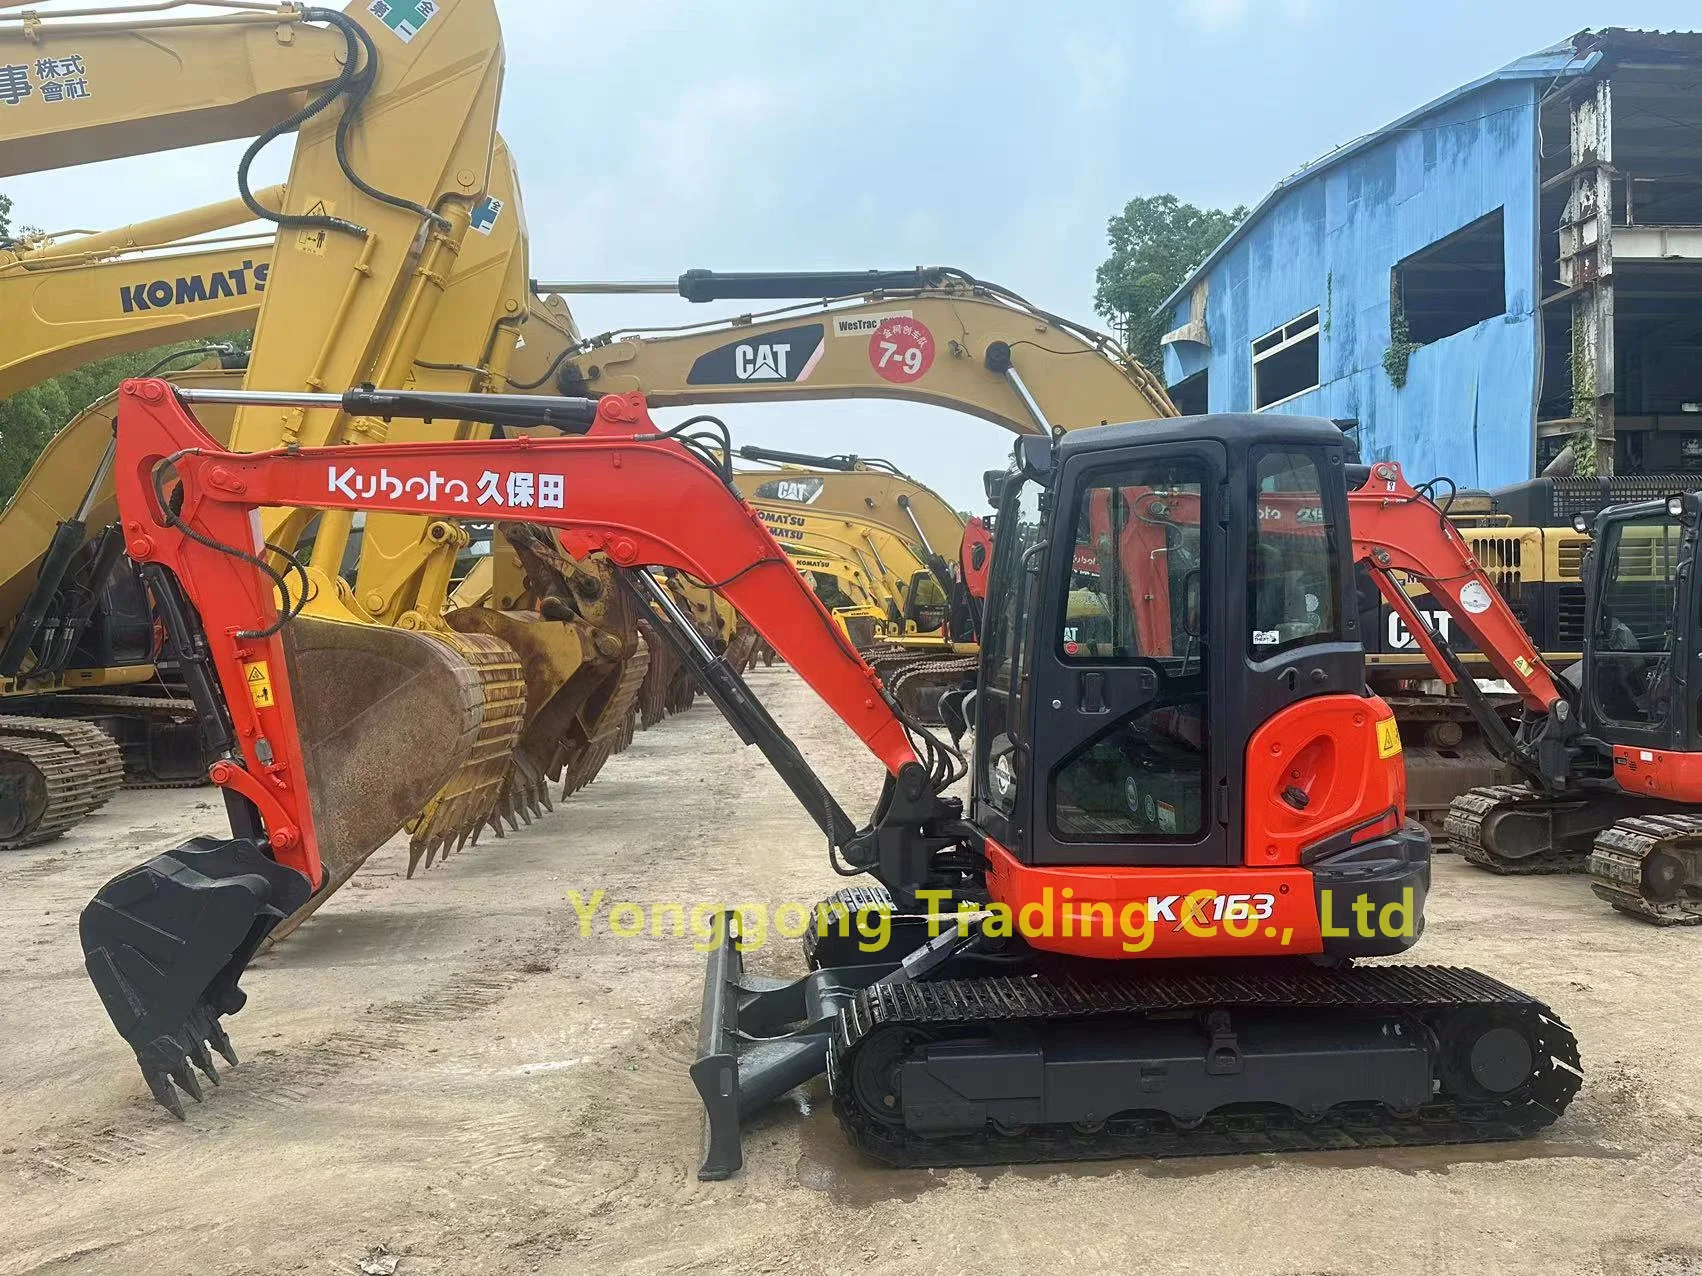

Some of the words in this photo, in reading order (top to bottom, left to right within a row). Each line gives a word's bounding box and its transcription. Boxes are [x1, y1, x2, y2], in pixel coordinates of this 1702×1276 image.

[34, 54, 86, 80] 株式
[39, 78, 91, 102] 會社
[839, 319, 877, 331] WesTrac
[735, 343, 791, 380] CAT
[878, 341, 922, 375] 7-9
[328, 466, 469, 503] Kubota
[476, 470, 564, 509] 久保田
[777, 481, 807, 502] CAT
[1147, 893, 1275, 932] KX163
